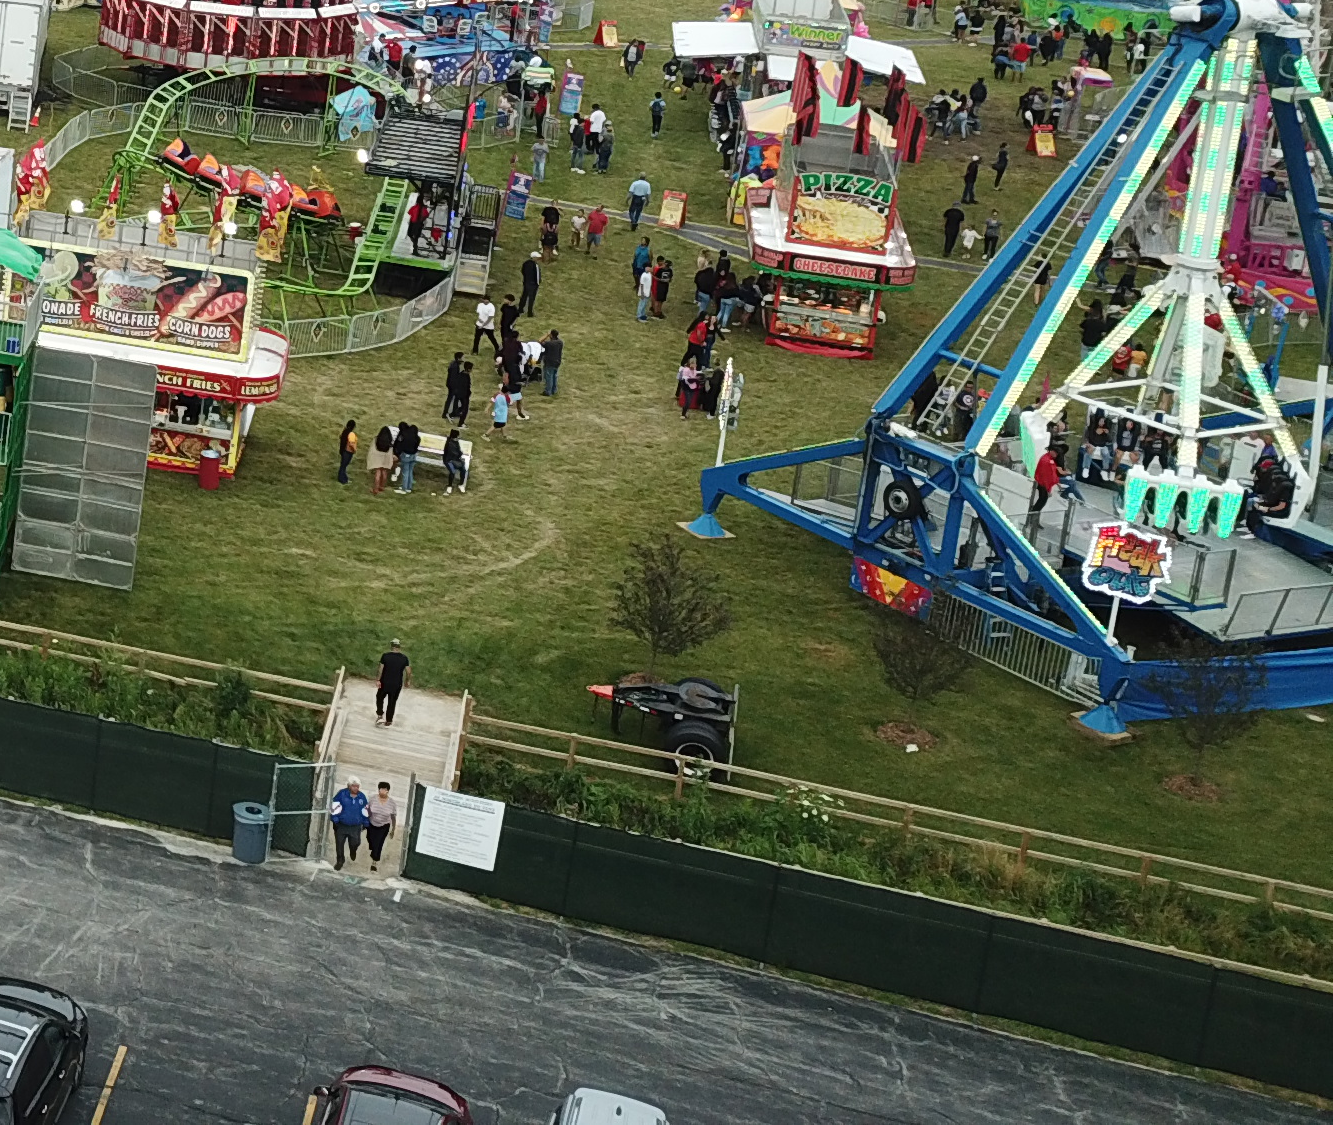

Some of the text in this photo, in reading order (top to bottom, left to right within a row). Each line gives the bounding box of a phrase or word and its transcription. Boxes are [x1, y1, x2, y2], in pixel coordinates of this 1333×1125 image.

[790, 23, 843, 42] Winner
[800, 172, 895, 205] PIZZA
[793, 257, 876, 282] CHEESECAKE
[42, 300, 81, 315] ONADE
[90, 304, 129, 325] FRENCH
[131, 312, 161, 327] FRIES
[169, 318, 199, 337] CORN
[201, 323, 231, 340] DOGS
[157, 374, 183, 385] NCH
[186, 378, 221, 391] FRIES
